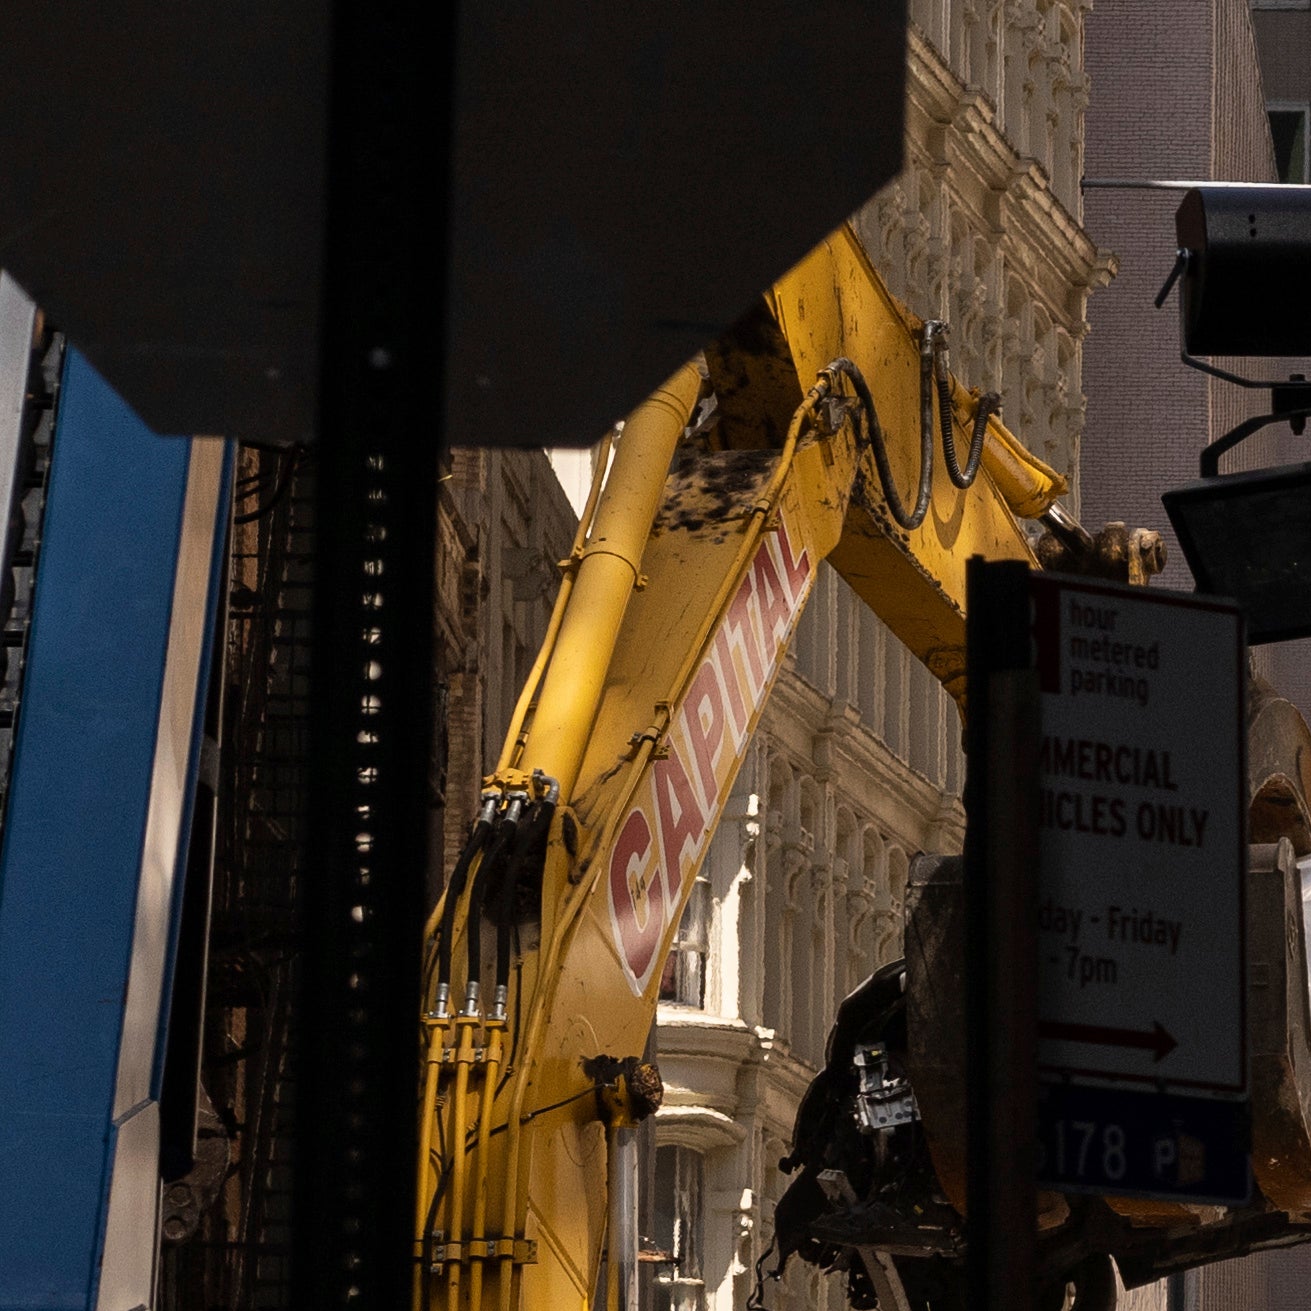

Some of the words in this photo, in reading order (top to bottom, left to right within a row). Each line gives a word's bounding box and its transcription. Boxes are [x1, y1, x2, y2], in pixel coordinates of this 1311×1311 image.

[1070, 602, 1118, 631] hour
[1070, 637, 1160, 670] metered
[1070, 670, 1148, 707] parking
[609, 508, 811, 997] CAPITAL
[1039, 736, 1178, 791] MMERCIAL
[1137, 802, 1208, 847] ONLY
[1038, 901, 1082, 942] day
[1108, 905, 1182, 955] Friday
[1065, 947, 1118, 988] 7pm
